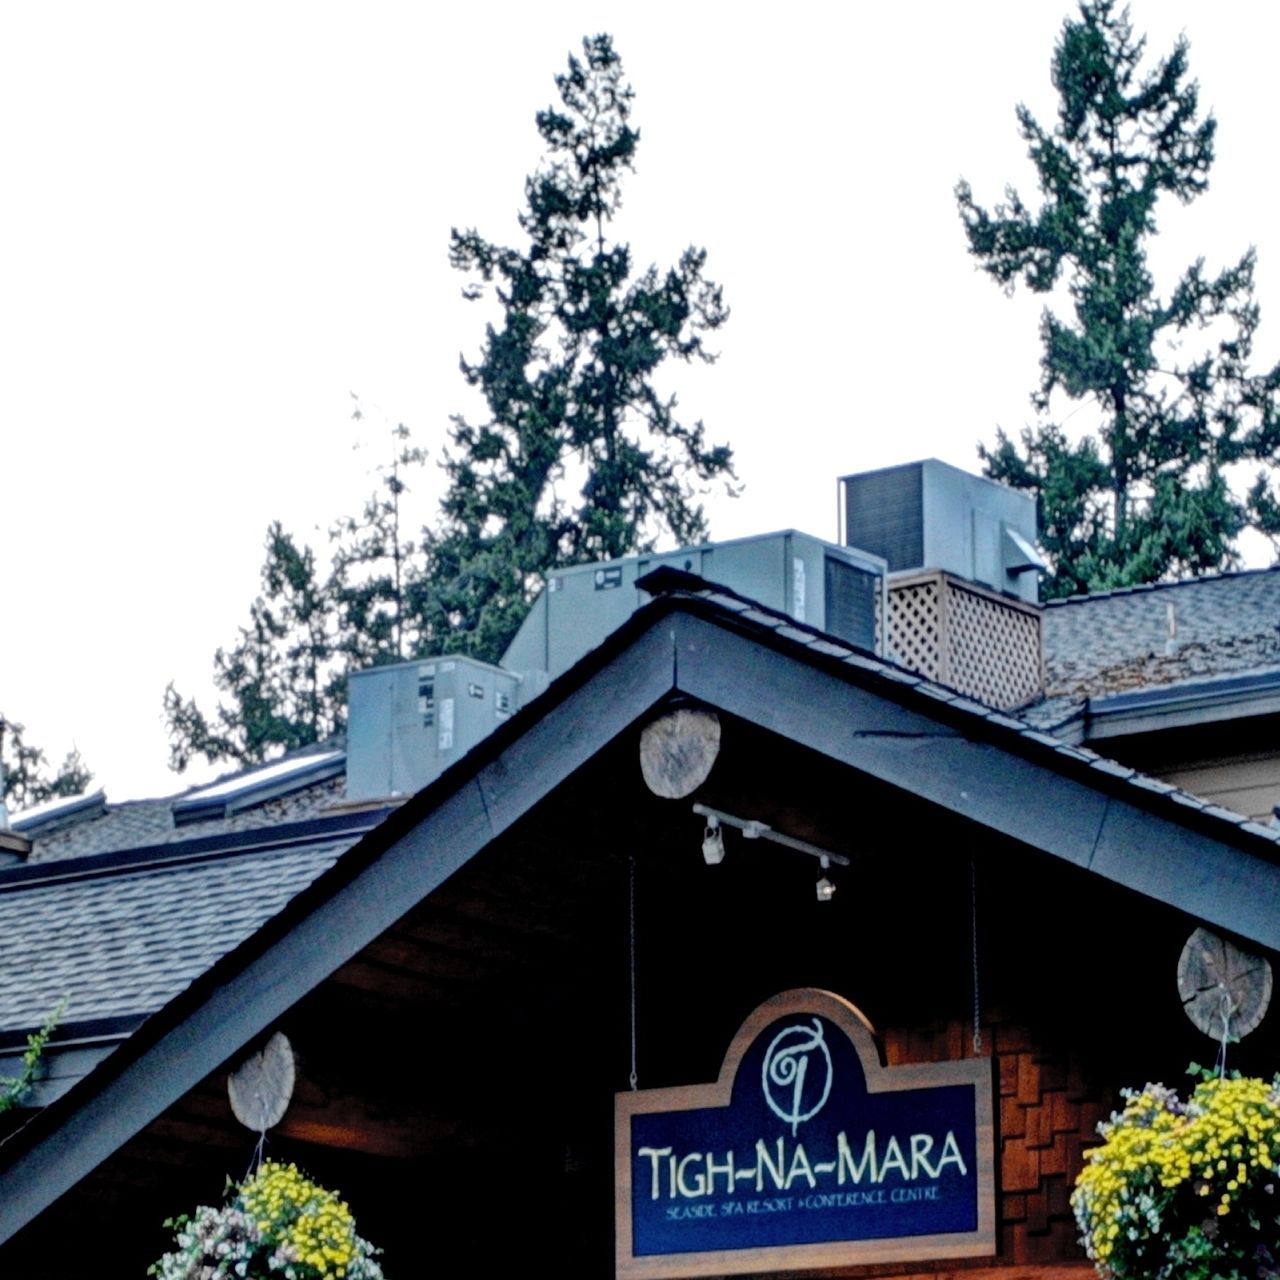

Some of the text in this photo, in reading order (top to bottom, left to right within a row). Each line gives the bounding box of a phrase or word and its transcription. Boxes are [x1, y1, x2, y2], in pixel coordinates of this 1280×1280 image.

[638, 1129, 967, 1201] TIGH-NA-MARA
[665, 1205, 717, 1220] SEASIDE
[721, 1201, 744, 1217] SPA
[747, 1196, 794, 1213] RESORT
[891, 1186, 941, 1203] CENTRE
